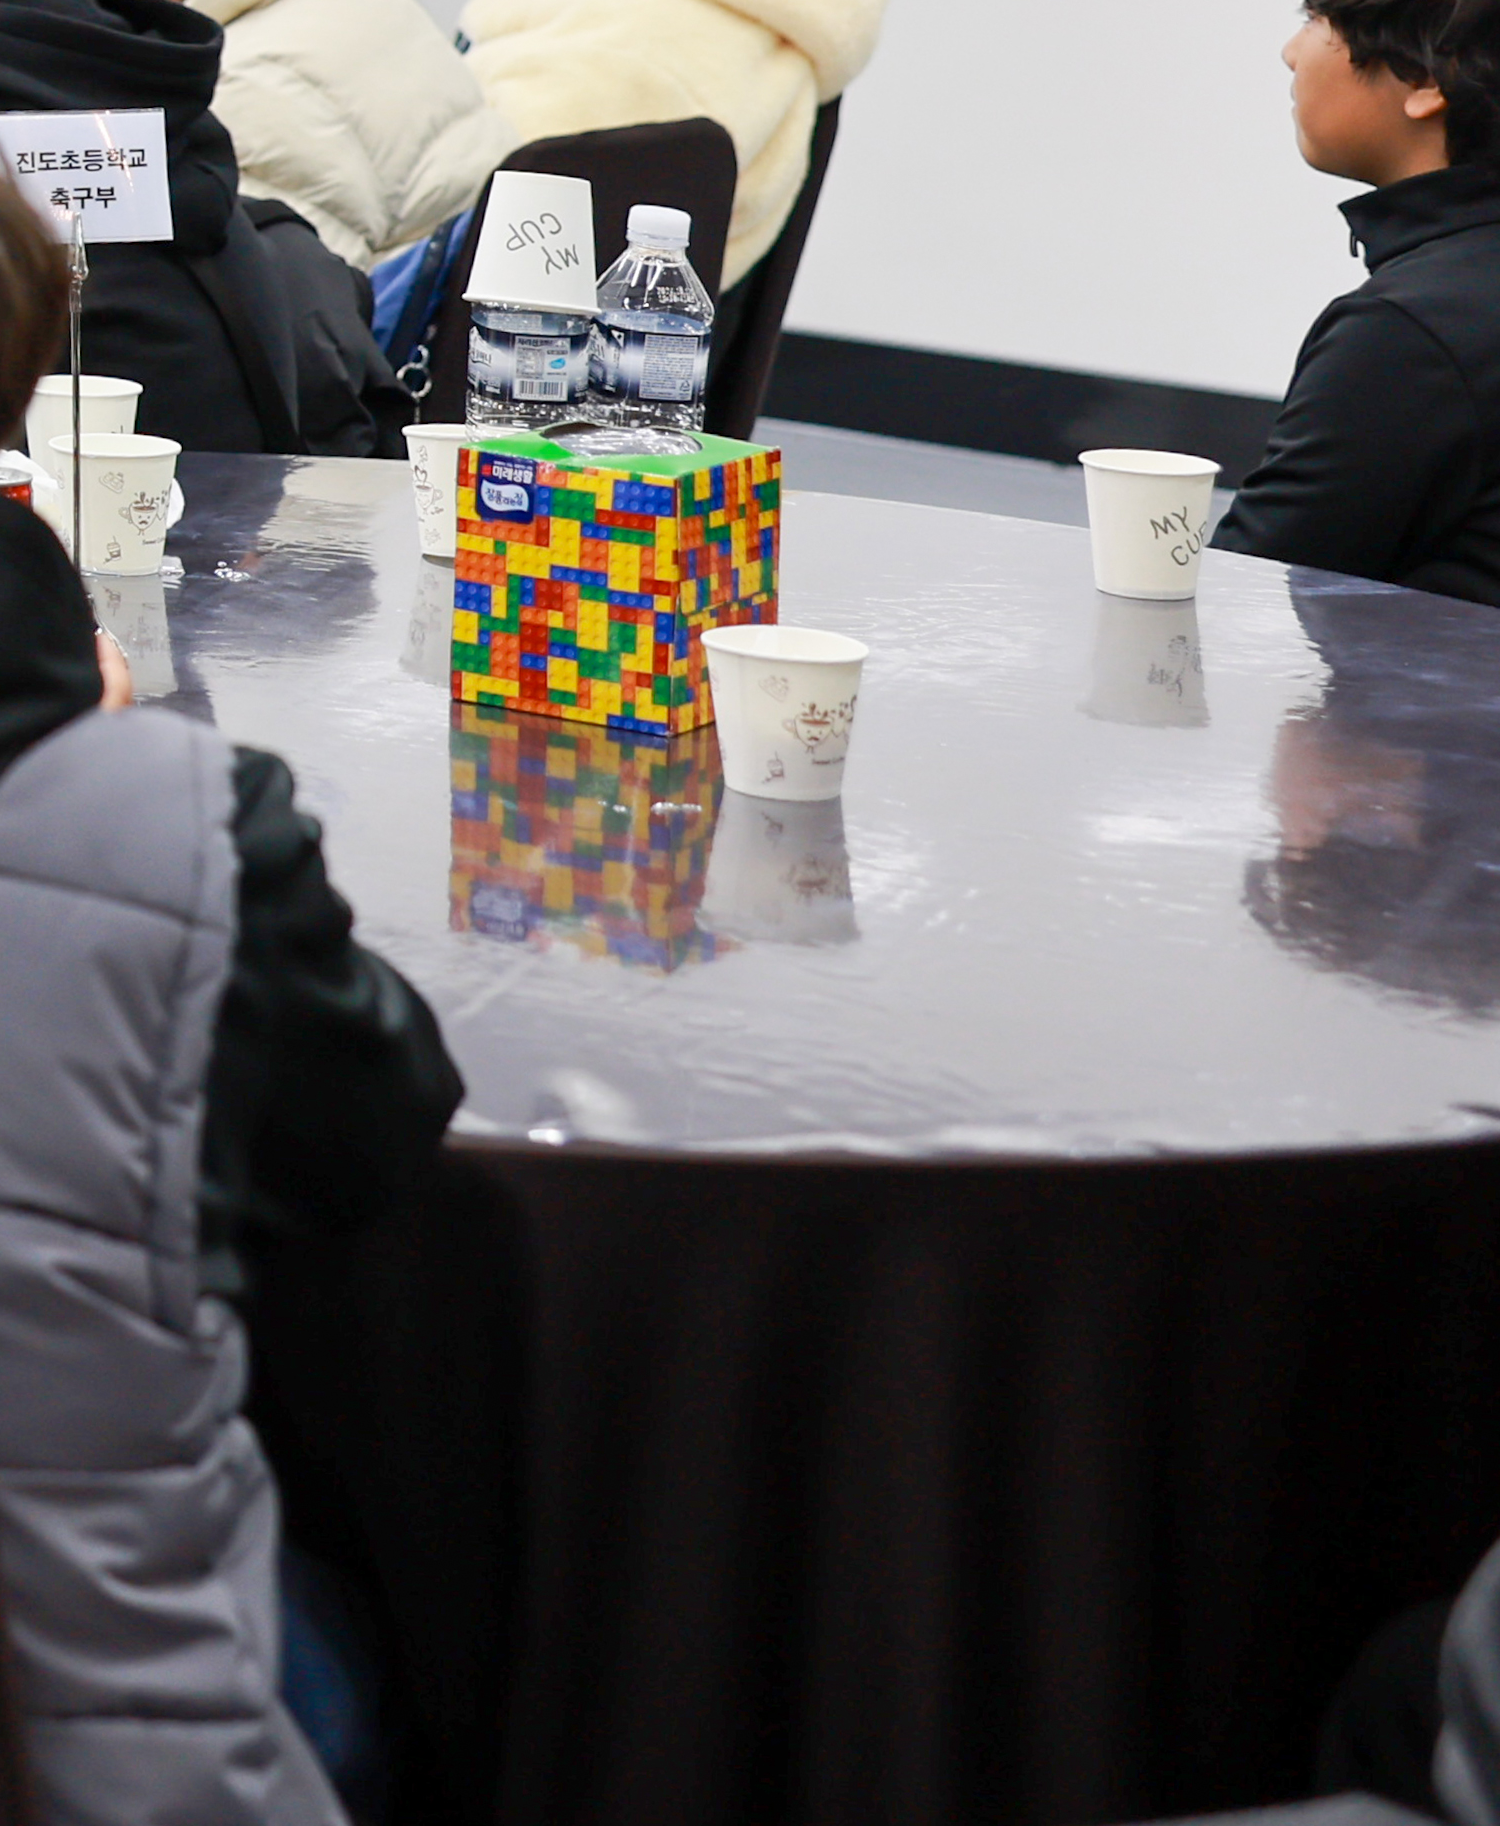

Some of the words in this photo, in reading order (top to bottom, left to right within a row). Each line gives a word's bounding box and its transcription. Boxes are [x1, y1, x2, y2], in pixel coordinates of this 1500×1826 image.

[16, 147, 148, 174] 진도초등학교
[49, 186, 117, 210] 축구부
[506, 212, 562, 252] CUP
[541, 243, 580, 275] MY
[492, 465, 533, 484] 미래생활
[1149, 506, 1190, 540] MY
